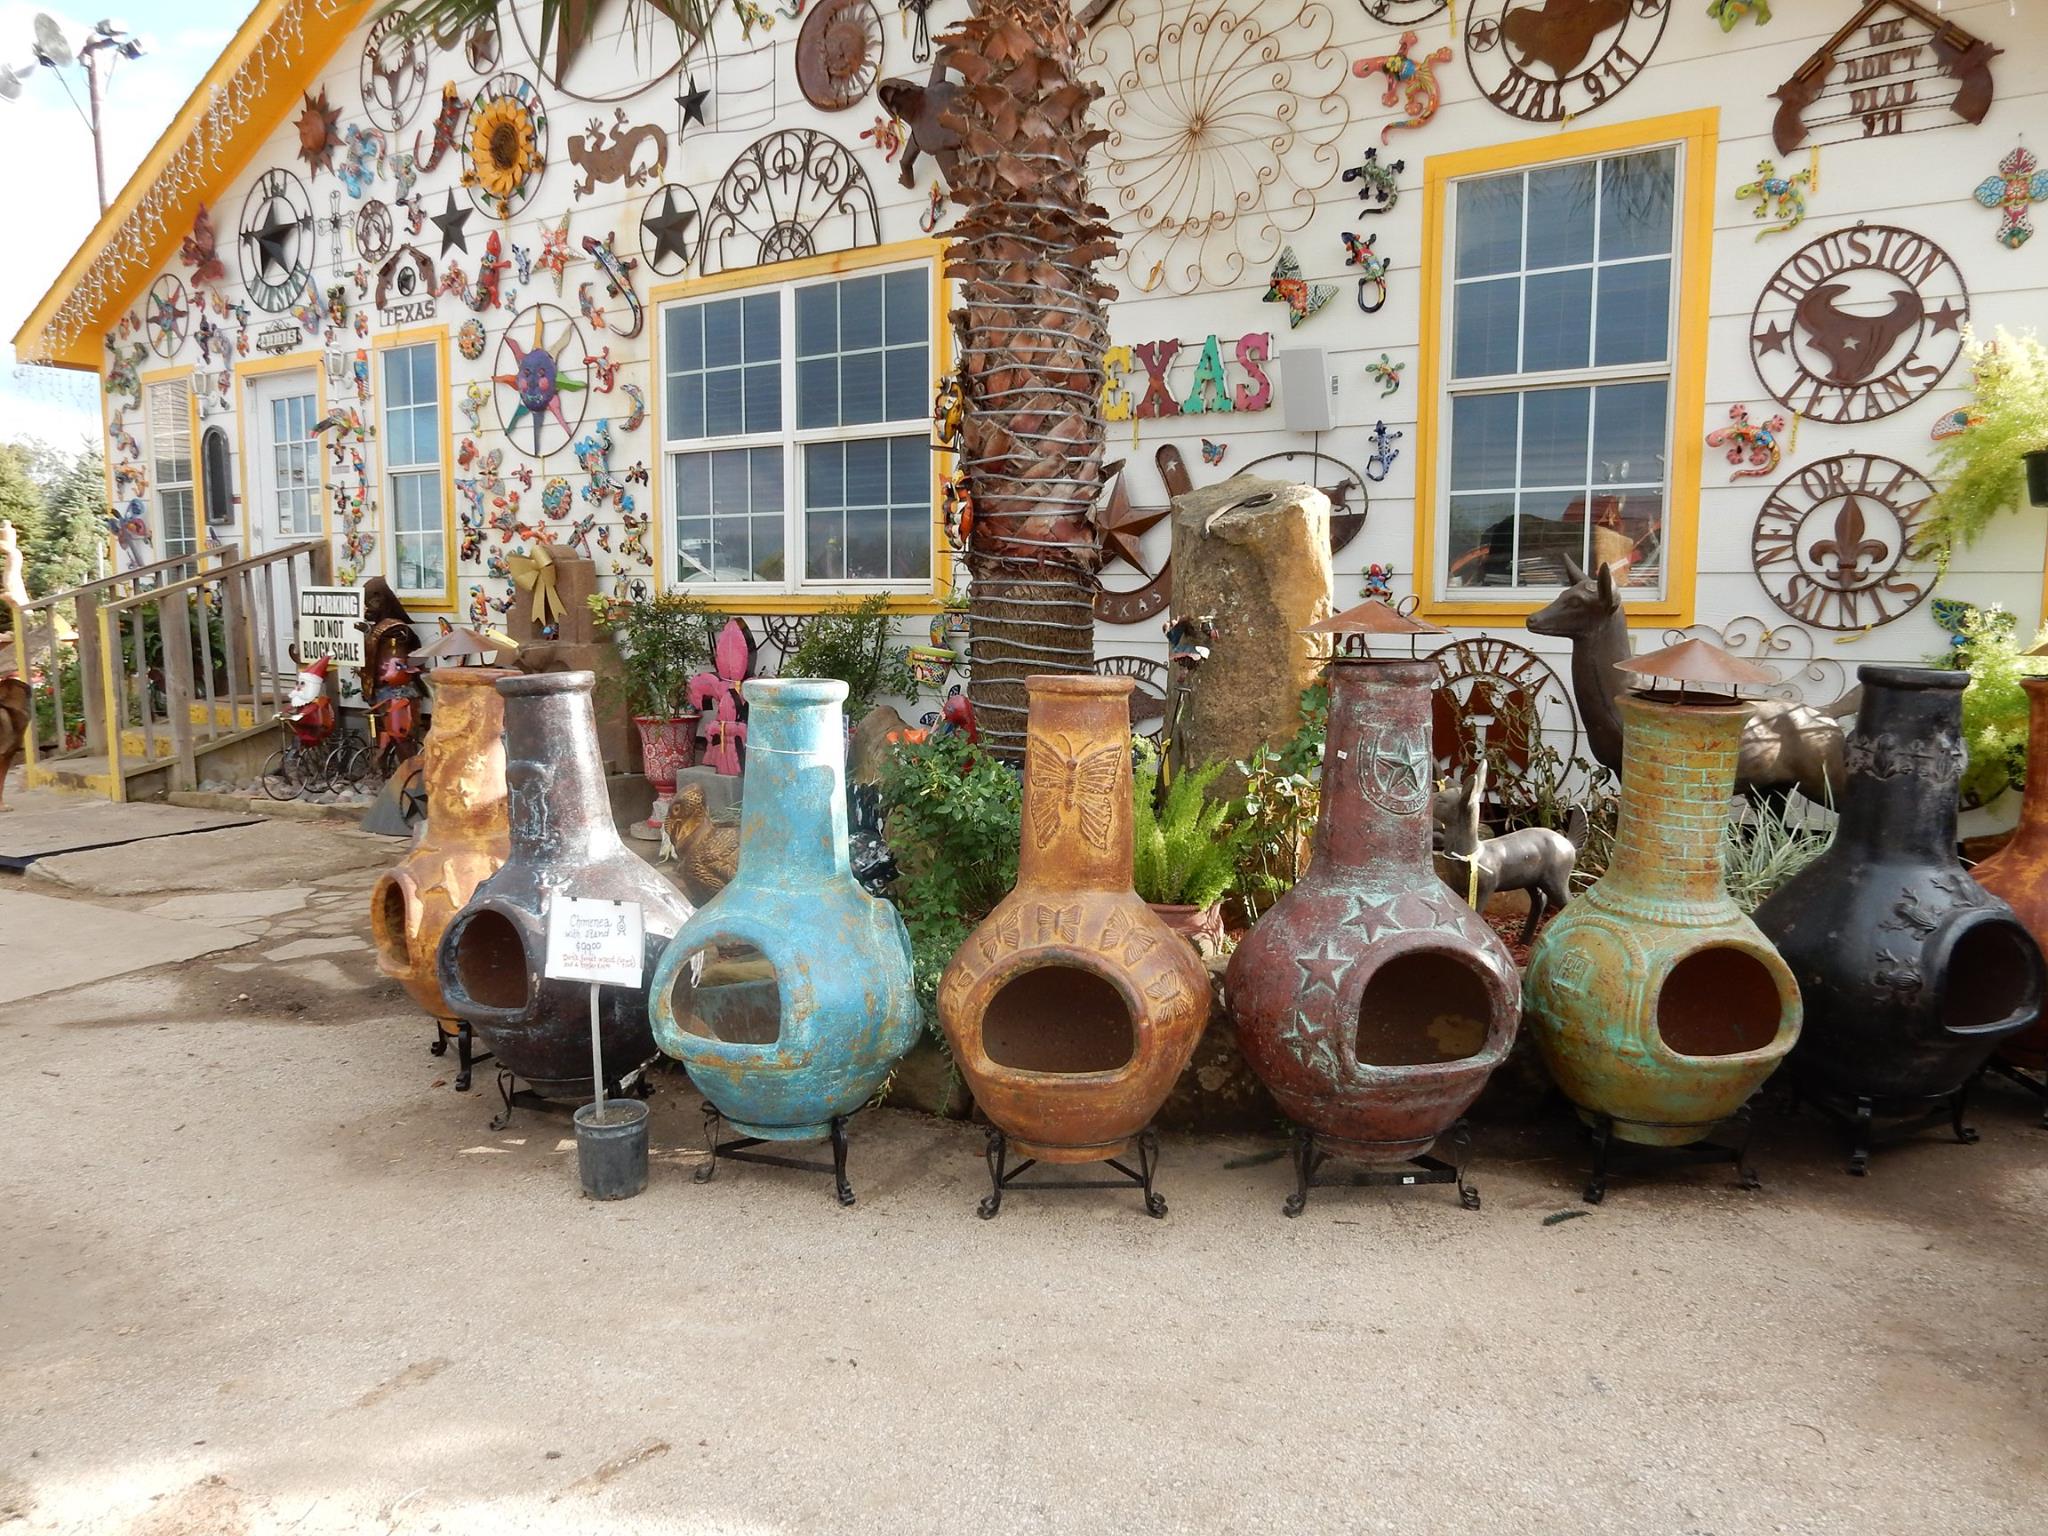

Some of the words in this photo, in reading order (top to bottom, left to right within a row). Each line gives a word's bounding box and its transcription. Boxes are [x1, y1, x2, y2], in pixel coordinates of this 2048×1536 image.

[1868, 19, 1906, 46] WE
[1582, 43, 1643, 104] 911
[1844, 47, 1922, 85] DON'T
[1489, 66, 1566, 121] DIAL
[1850, 80, 1918, 114] DIAL
[1862, 110, 1903, 138] 911
[1770, 229, 1949, 304] HOUSTON
[385, 301, 436, 325] TEXAS
[1100, 331, 1274, 422] EXAS
[1778, 352, 1943, 422] TEXANS
[1753, 494, 1804, 567] NEW
[303, 594, 314, 614] NO
[315, 595, 358, 616] PARKING
[1101, 589, 1163, 617] EXAS
[1774, 571, 1922, 628] SAINTS
[314, 619, 325, 638] DO
[327, 620, 344, 638] NOT
[331, 641, 359, 661] SCALE
